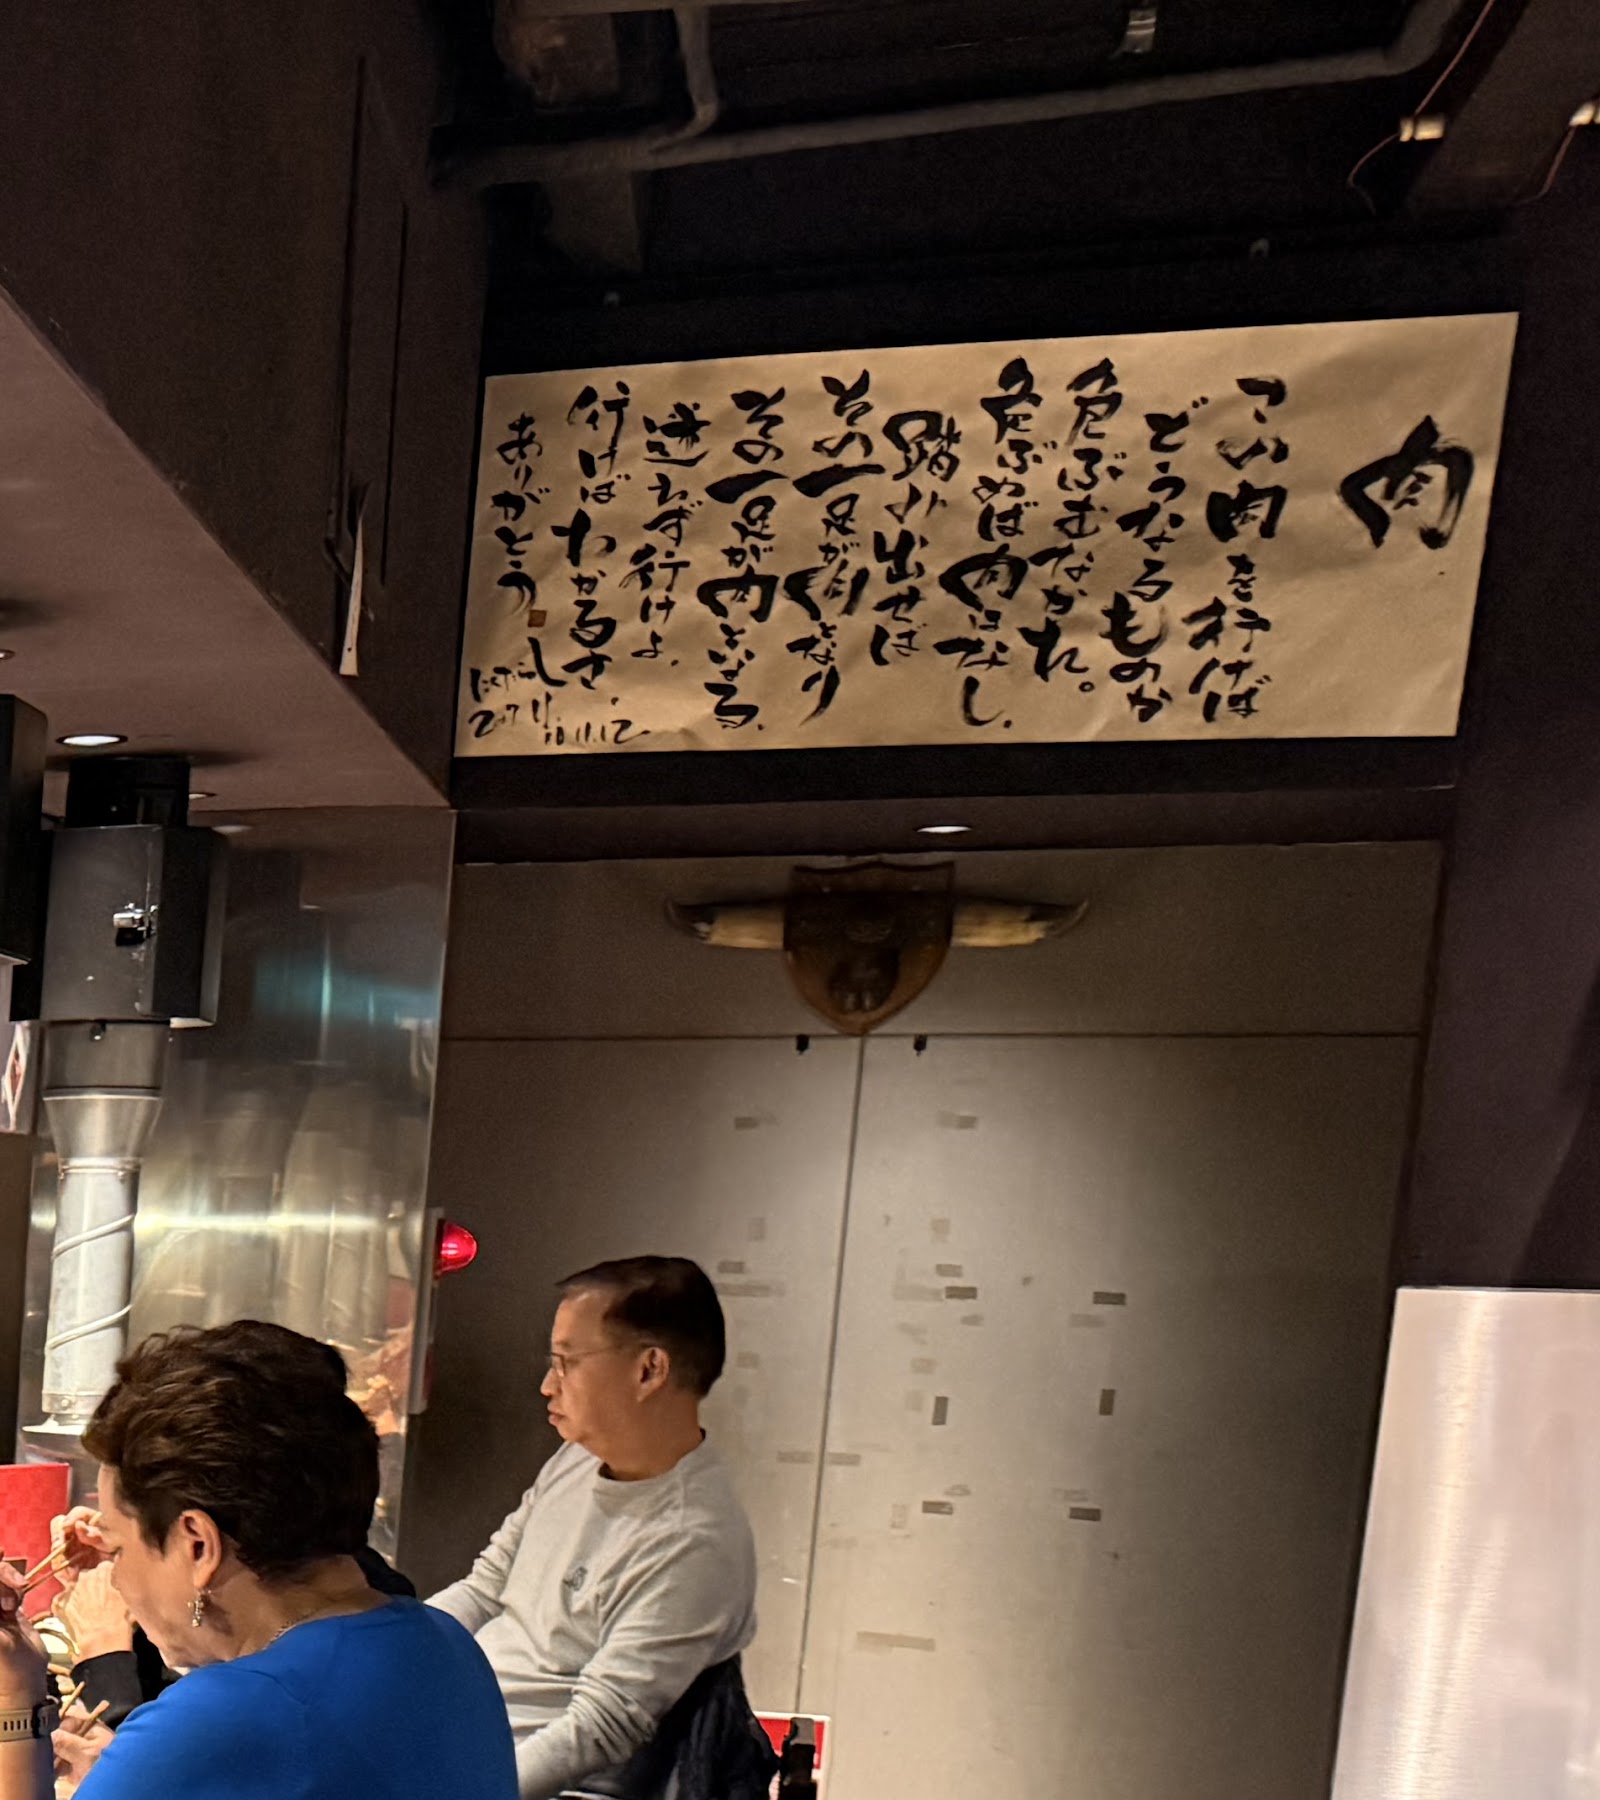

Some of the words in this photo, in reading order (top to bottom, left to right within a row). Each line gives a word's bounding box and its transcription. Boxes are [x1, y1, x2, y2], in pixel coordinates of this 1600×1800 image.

[491, 411, 551, 617] ありがとう
[1100, 396, 1209, 723] どうなるものか
[1340, 414, 1474, 550] 肉
